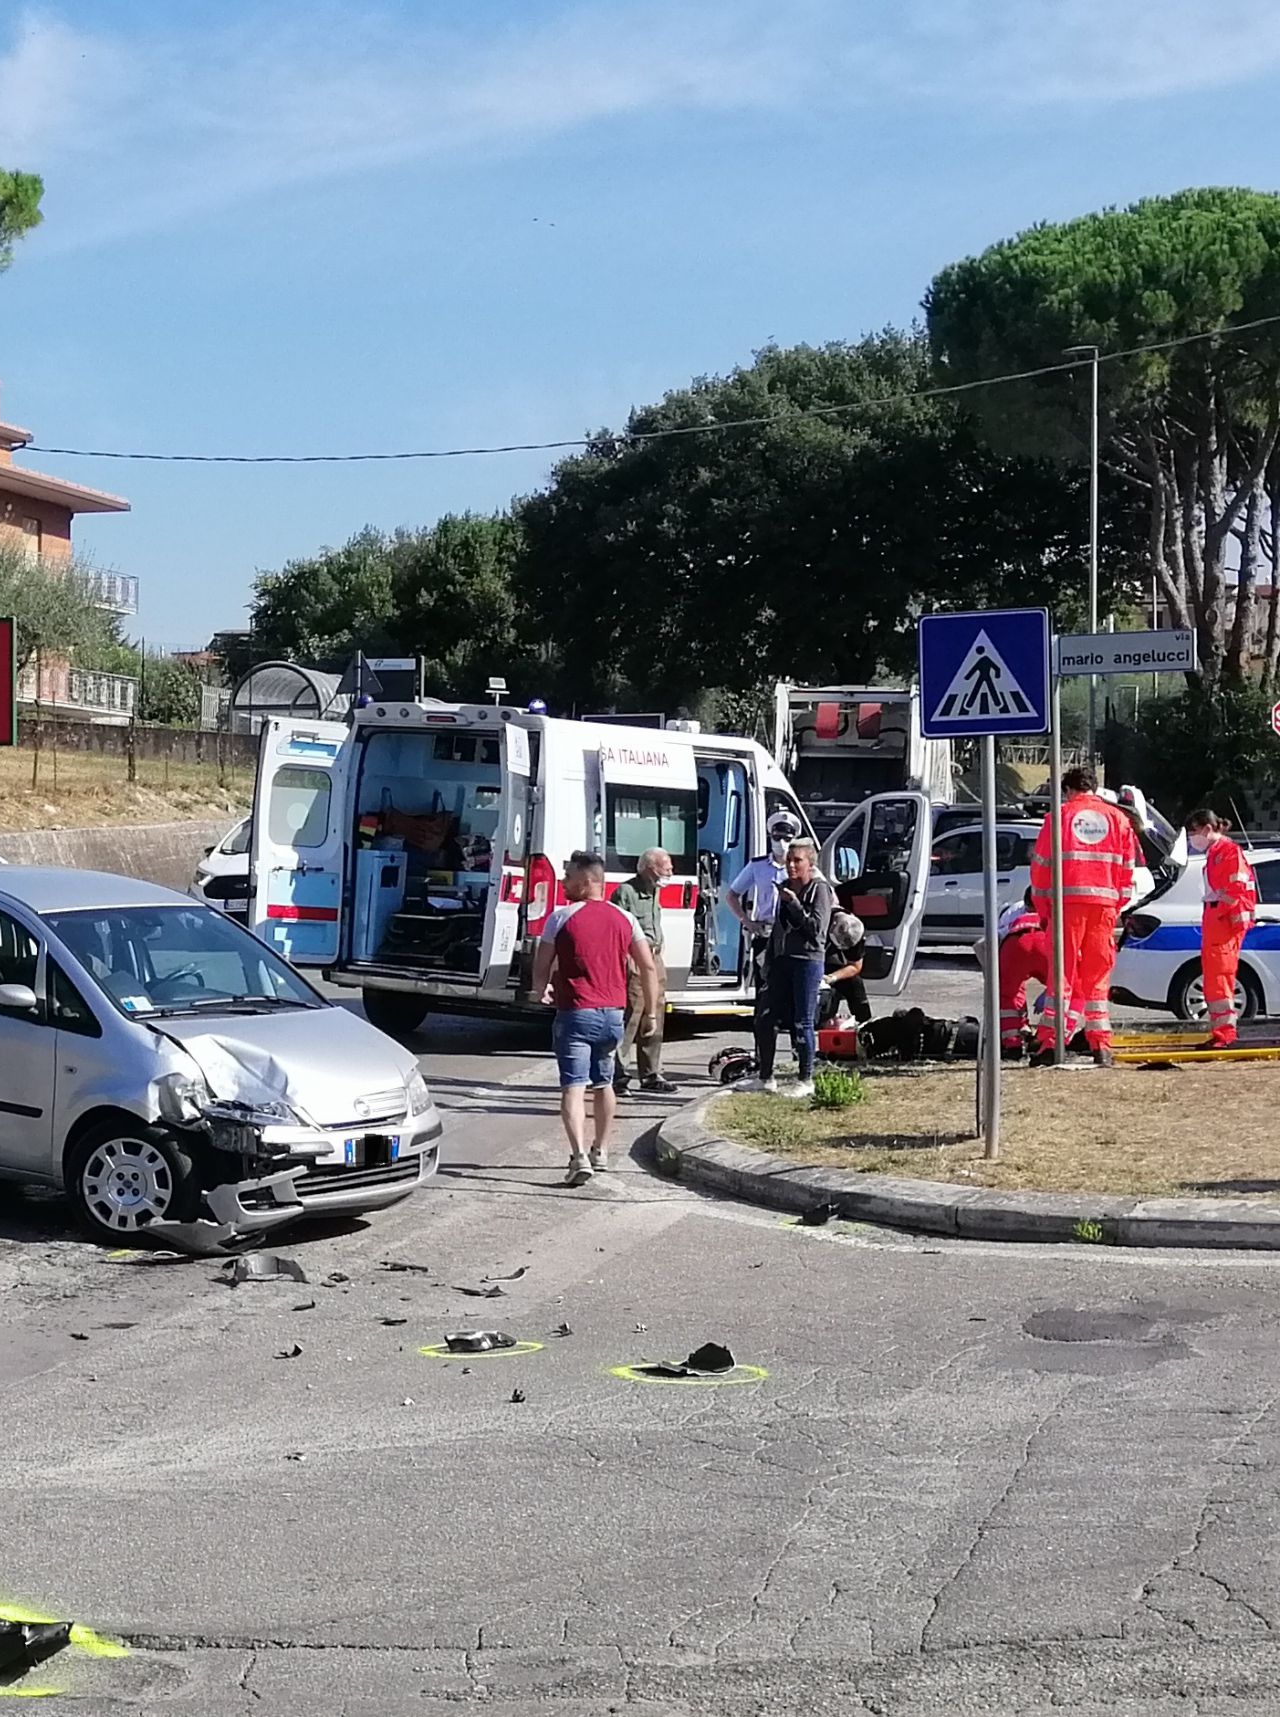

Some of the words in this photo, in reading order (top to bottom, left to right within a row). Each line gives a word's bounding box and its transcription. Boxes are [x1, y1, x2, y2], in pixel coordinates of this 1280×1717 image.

[1175, 633, 1190, 641] via
[1062, 652, 1104, 666] mario
[1113, 649, 1190, 666] angelucci
[618, 748, 670, 768] ITALIANA
